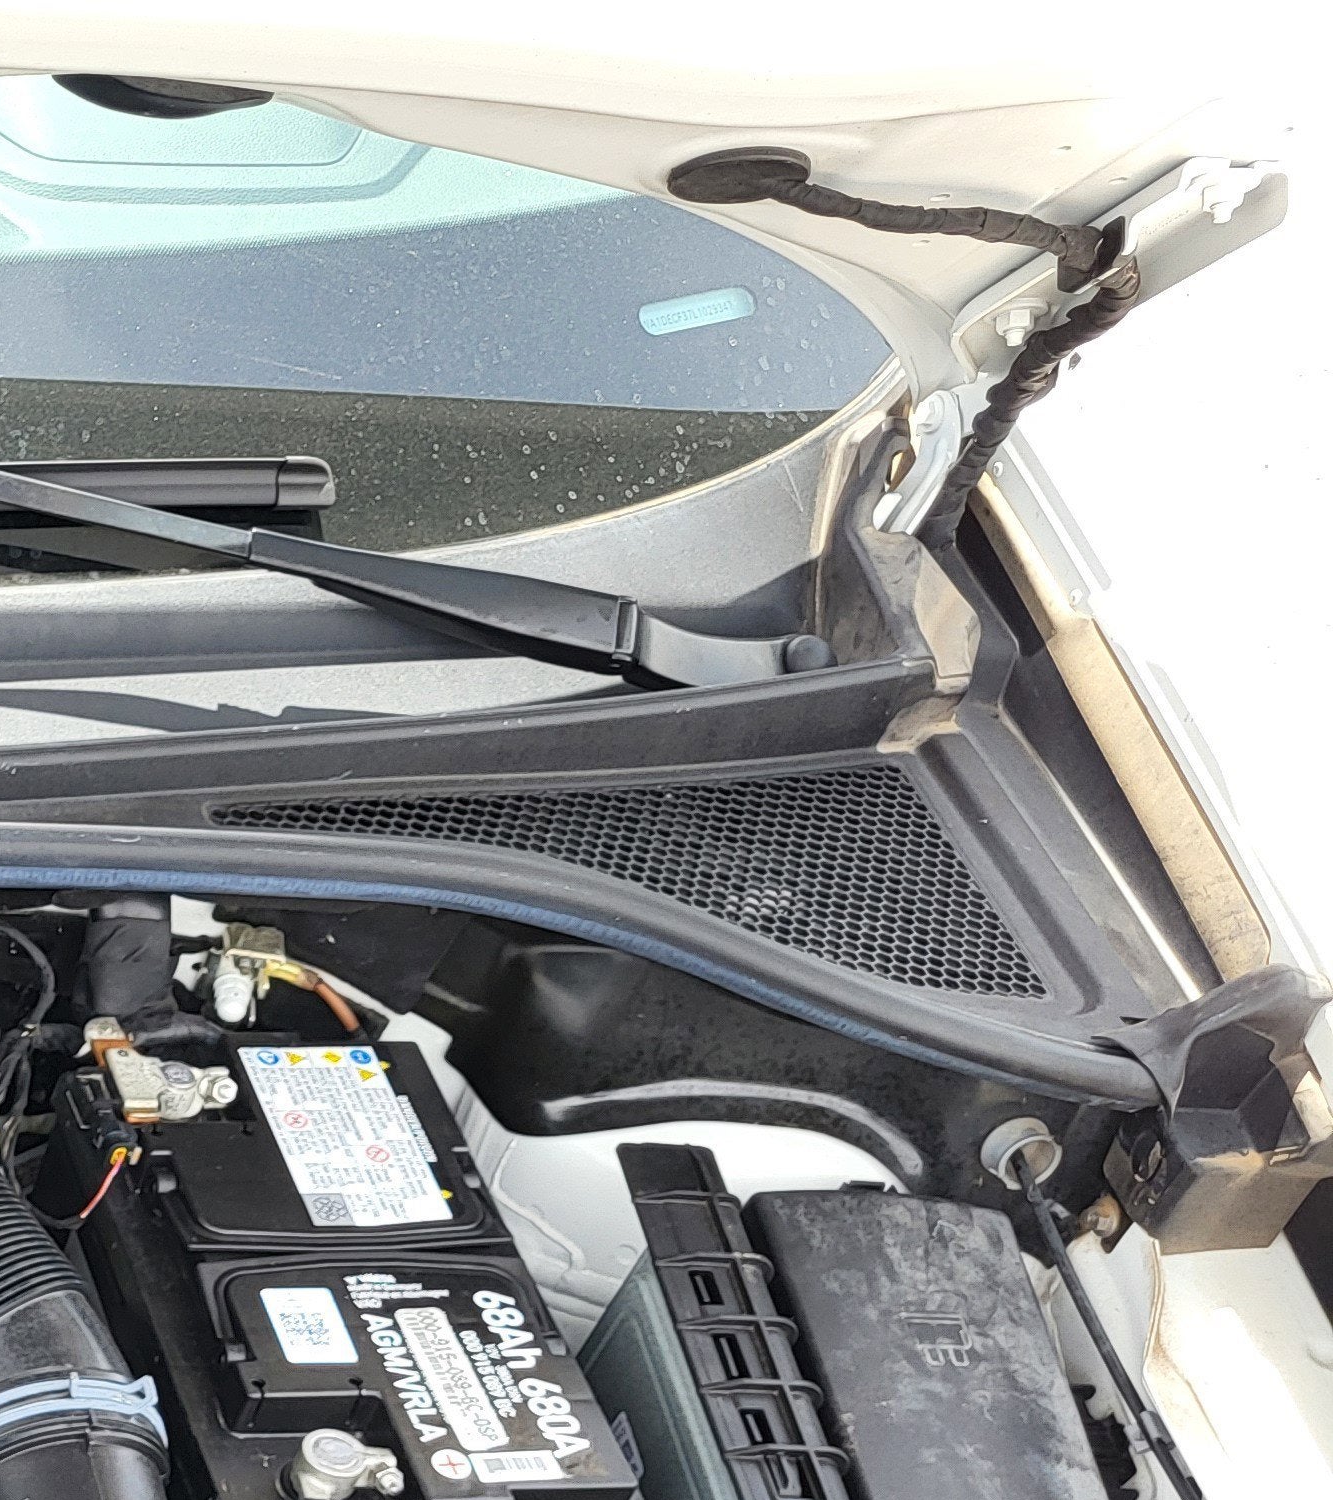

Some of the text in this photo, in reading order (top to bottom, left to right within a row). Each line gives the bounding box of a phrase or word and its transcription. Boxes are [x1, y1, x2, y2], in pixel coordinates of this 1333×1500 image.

[360, 1313, 448, 1443] AGM/VRLA
[472, 1290, 590, 1459] 68Ah 680A
